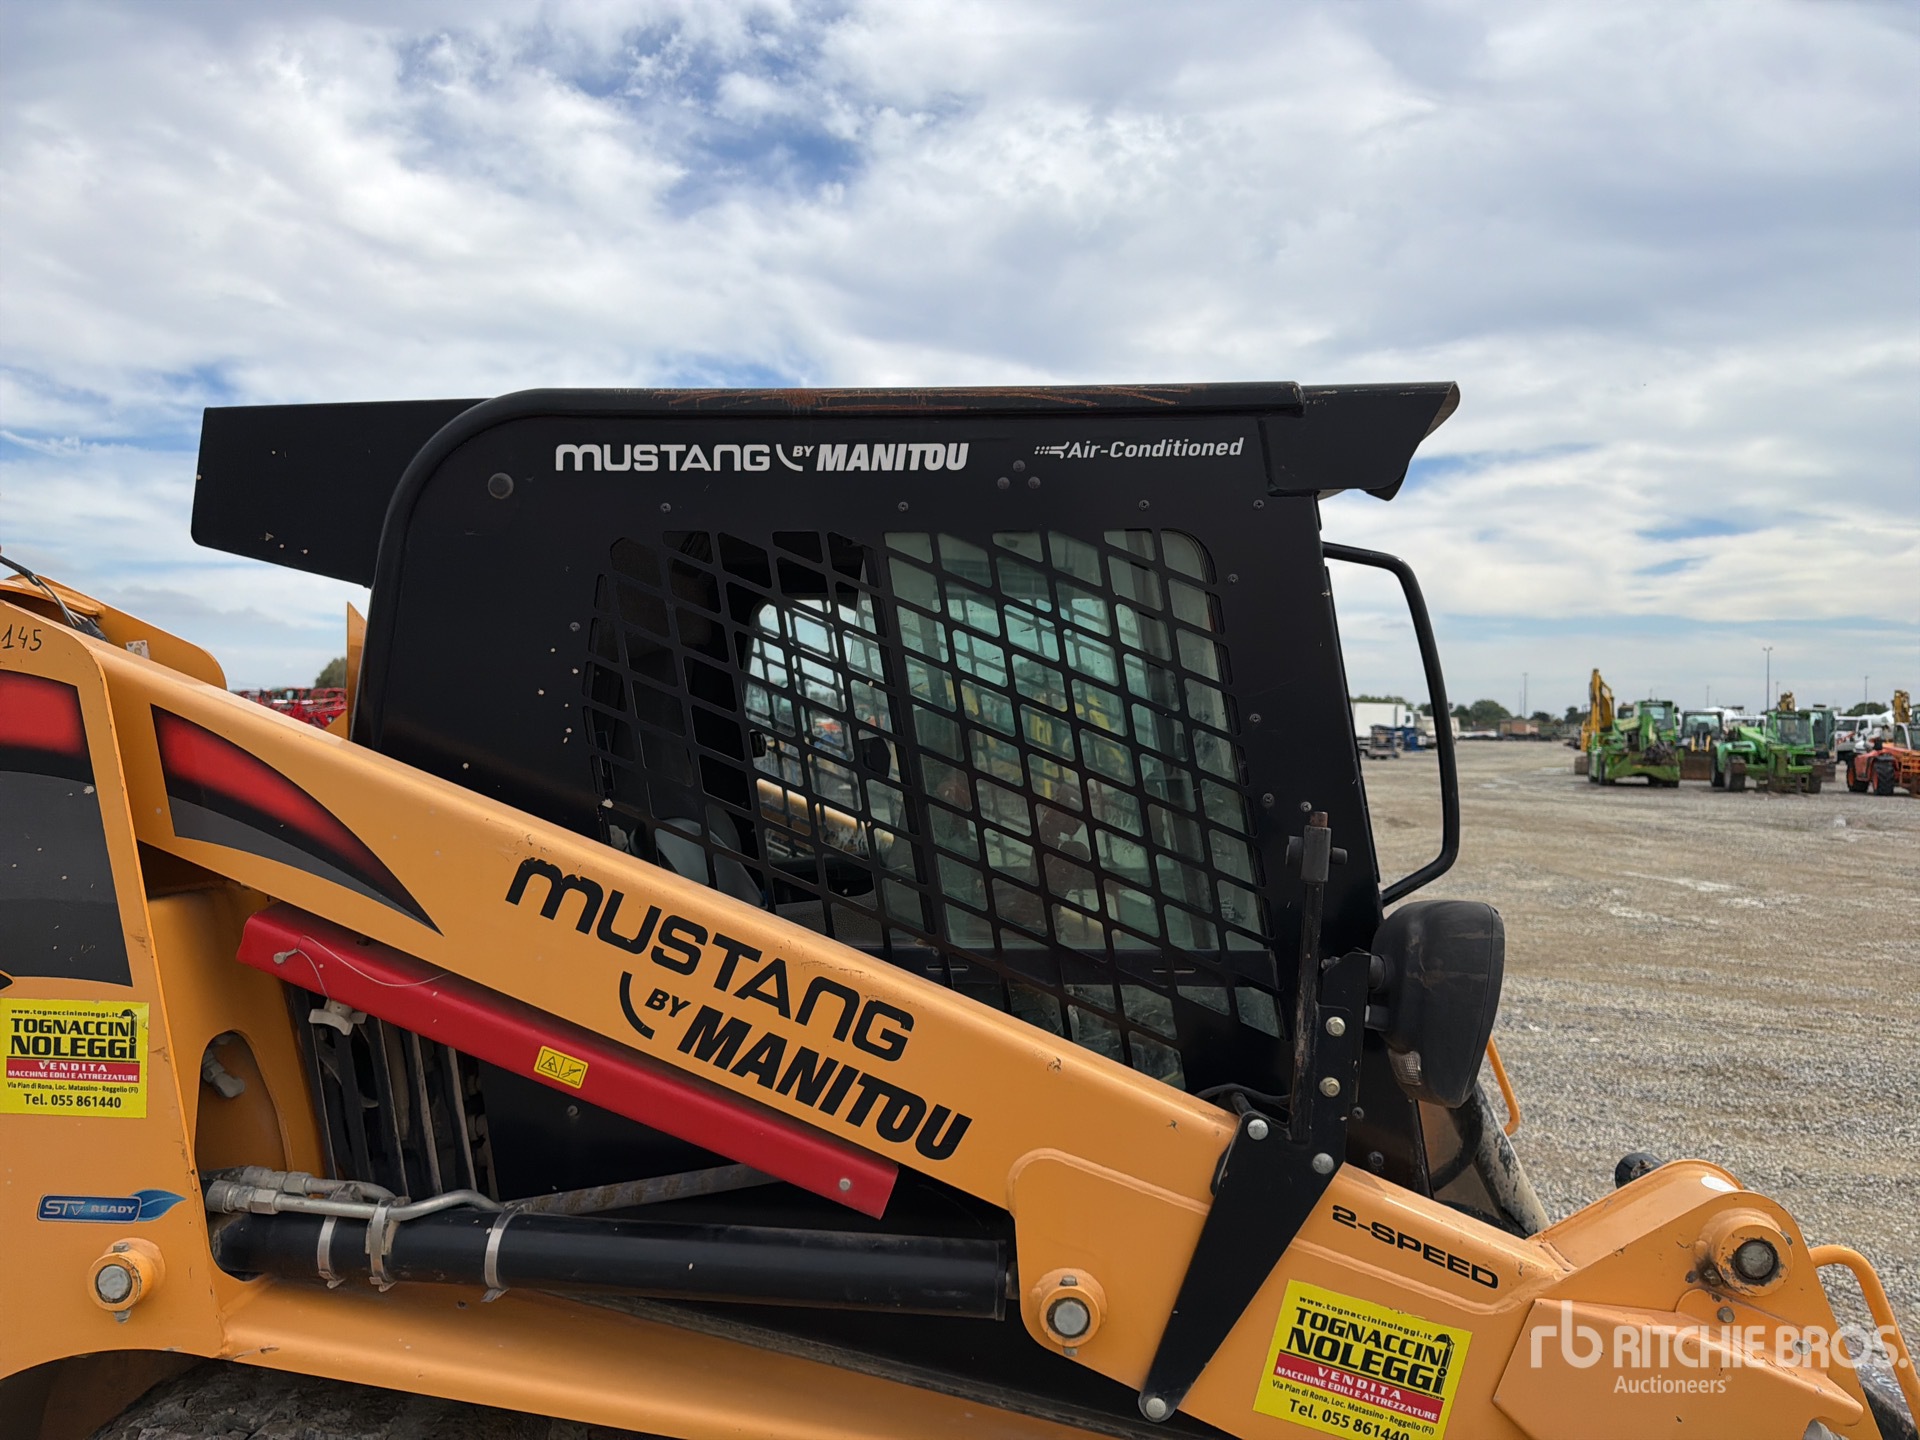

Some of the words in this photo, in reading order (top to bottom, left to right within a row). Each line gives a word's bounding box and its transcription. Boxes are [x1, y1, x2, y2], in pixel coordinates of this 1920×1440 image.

[555, 443, 771, 472] MUSTANG
[792, 445, 816, 458] BY
[816, 443, 970, 472] MANITOU
[1066, 437, 1245, 459] Air-Conditioned
[1, 623, 43, 652] 145
[505, 857, 915, 1062] MUSTANG
[11, 1009, 119, 1018] www.tognaccininoleggi.it
[7, 1070, 49, 1079] MACCHINE
[50, 1071, 70, 1079] EDILI
[77, 1073, 138, 1081] ATTREZZATURE
[38, 1062, 108, 1073] VENDITA
[644, 988, 692, 1018] BY
[676, 1005, 973, 1161] MANITOU
[23, 1094, 48, 1106] Tel.
[50, 1094, 74, 1107] 055
[76, 1096, 122, 1109] 861440
[37, 1083, 54, 1091] Rona,
[55, 1083, 67, 1091] Loc.
[68, 1084, 98, 1092] Matassino
[102, 1085, 128, 1094] Reggello
[90, 1205, 136, 1214] READY
[1332, 1204, 1499, 1290] 2-SPEED
[1299, 1296, 1433, 1341] www.tognaccininoleggi.it
[1276, 1366, 1327, 1389] MACCHINE
[1327, 1381, 1354, 1396] EDILI
[1354, 1390, 1362, 1398] E
[1361, 1392, 1438, 1422] ATTREZZATURE
[1317, 1366, 1402, 1401] VENDITA
[1272, 1379, 1284, 1390] Via
[1284, 1383, 1301, 1395] Pian
[1301, 1388, 1309, 1397] di
[1309, 1391, 1330, 1406] Rona,
[1331, 1397, 1346, 1409] Loc.
[1347, 1402, 1385, 1421] Matassino
[1389, 1414, 1421, 1432] Reggello
[1289, 1398, 1318, 1420] Tel.
[1321, 1409, 1351, 1429] 055
